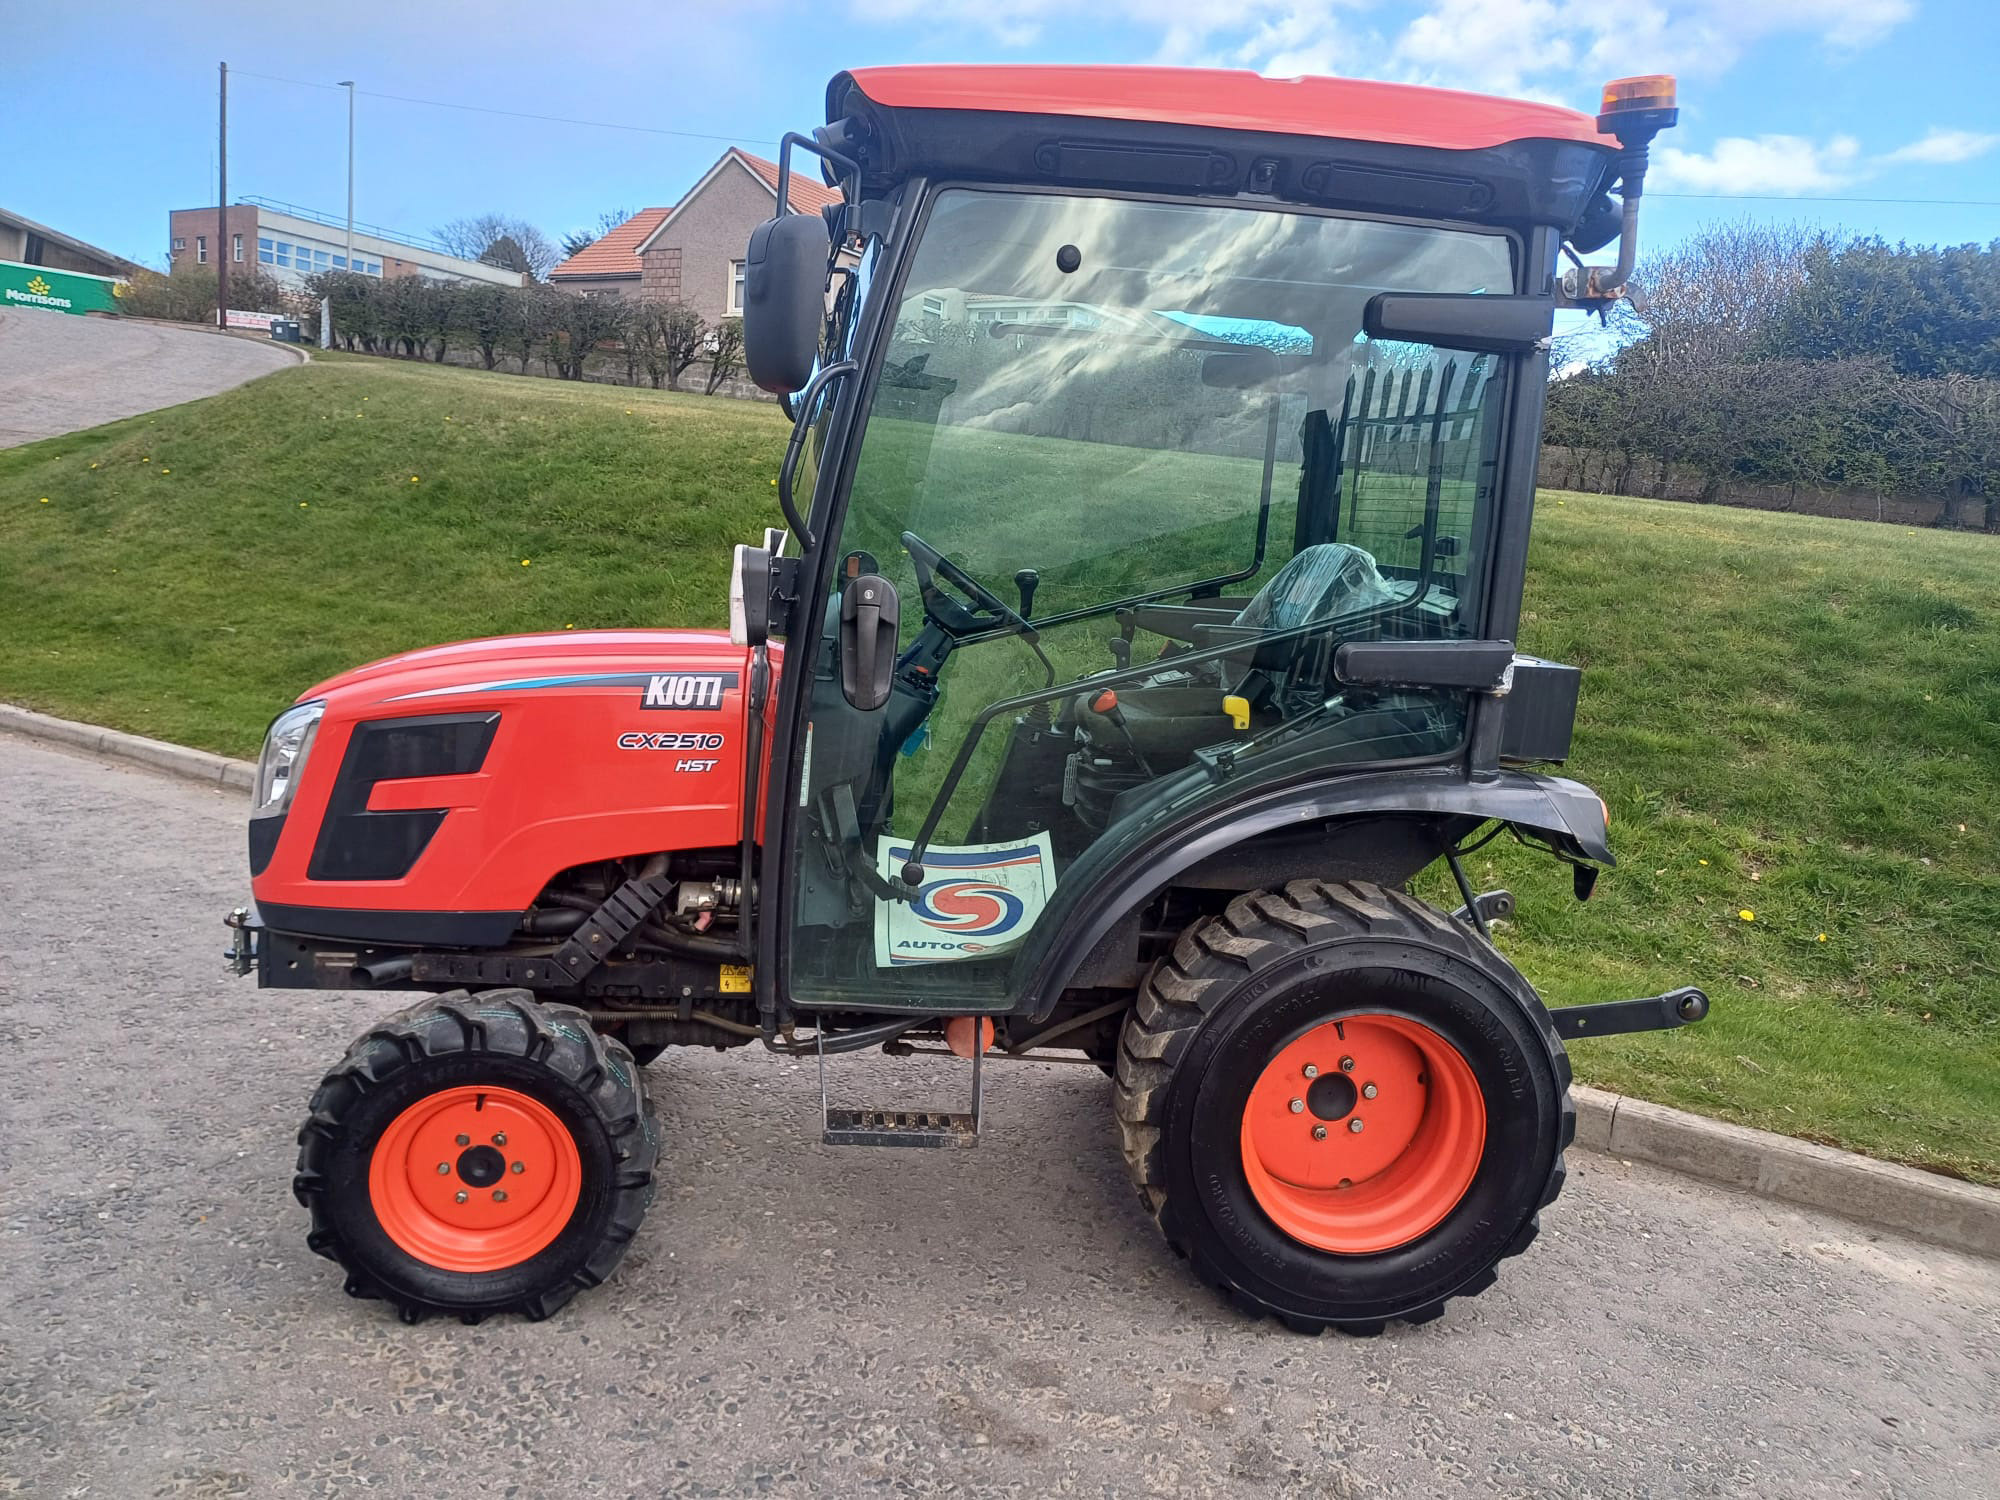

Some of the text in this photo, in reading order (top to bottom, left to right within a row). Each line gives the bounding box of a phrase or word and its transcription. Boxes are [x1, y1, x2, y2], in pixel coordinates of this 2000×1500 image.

[5, 288, 72, 308] Morrisons
[646, 676, 723, 706] KIOTI
[617, 732, 725, 751] CX2510
[675, 760, 718, 772] HST
